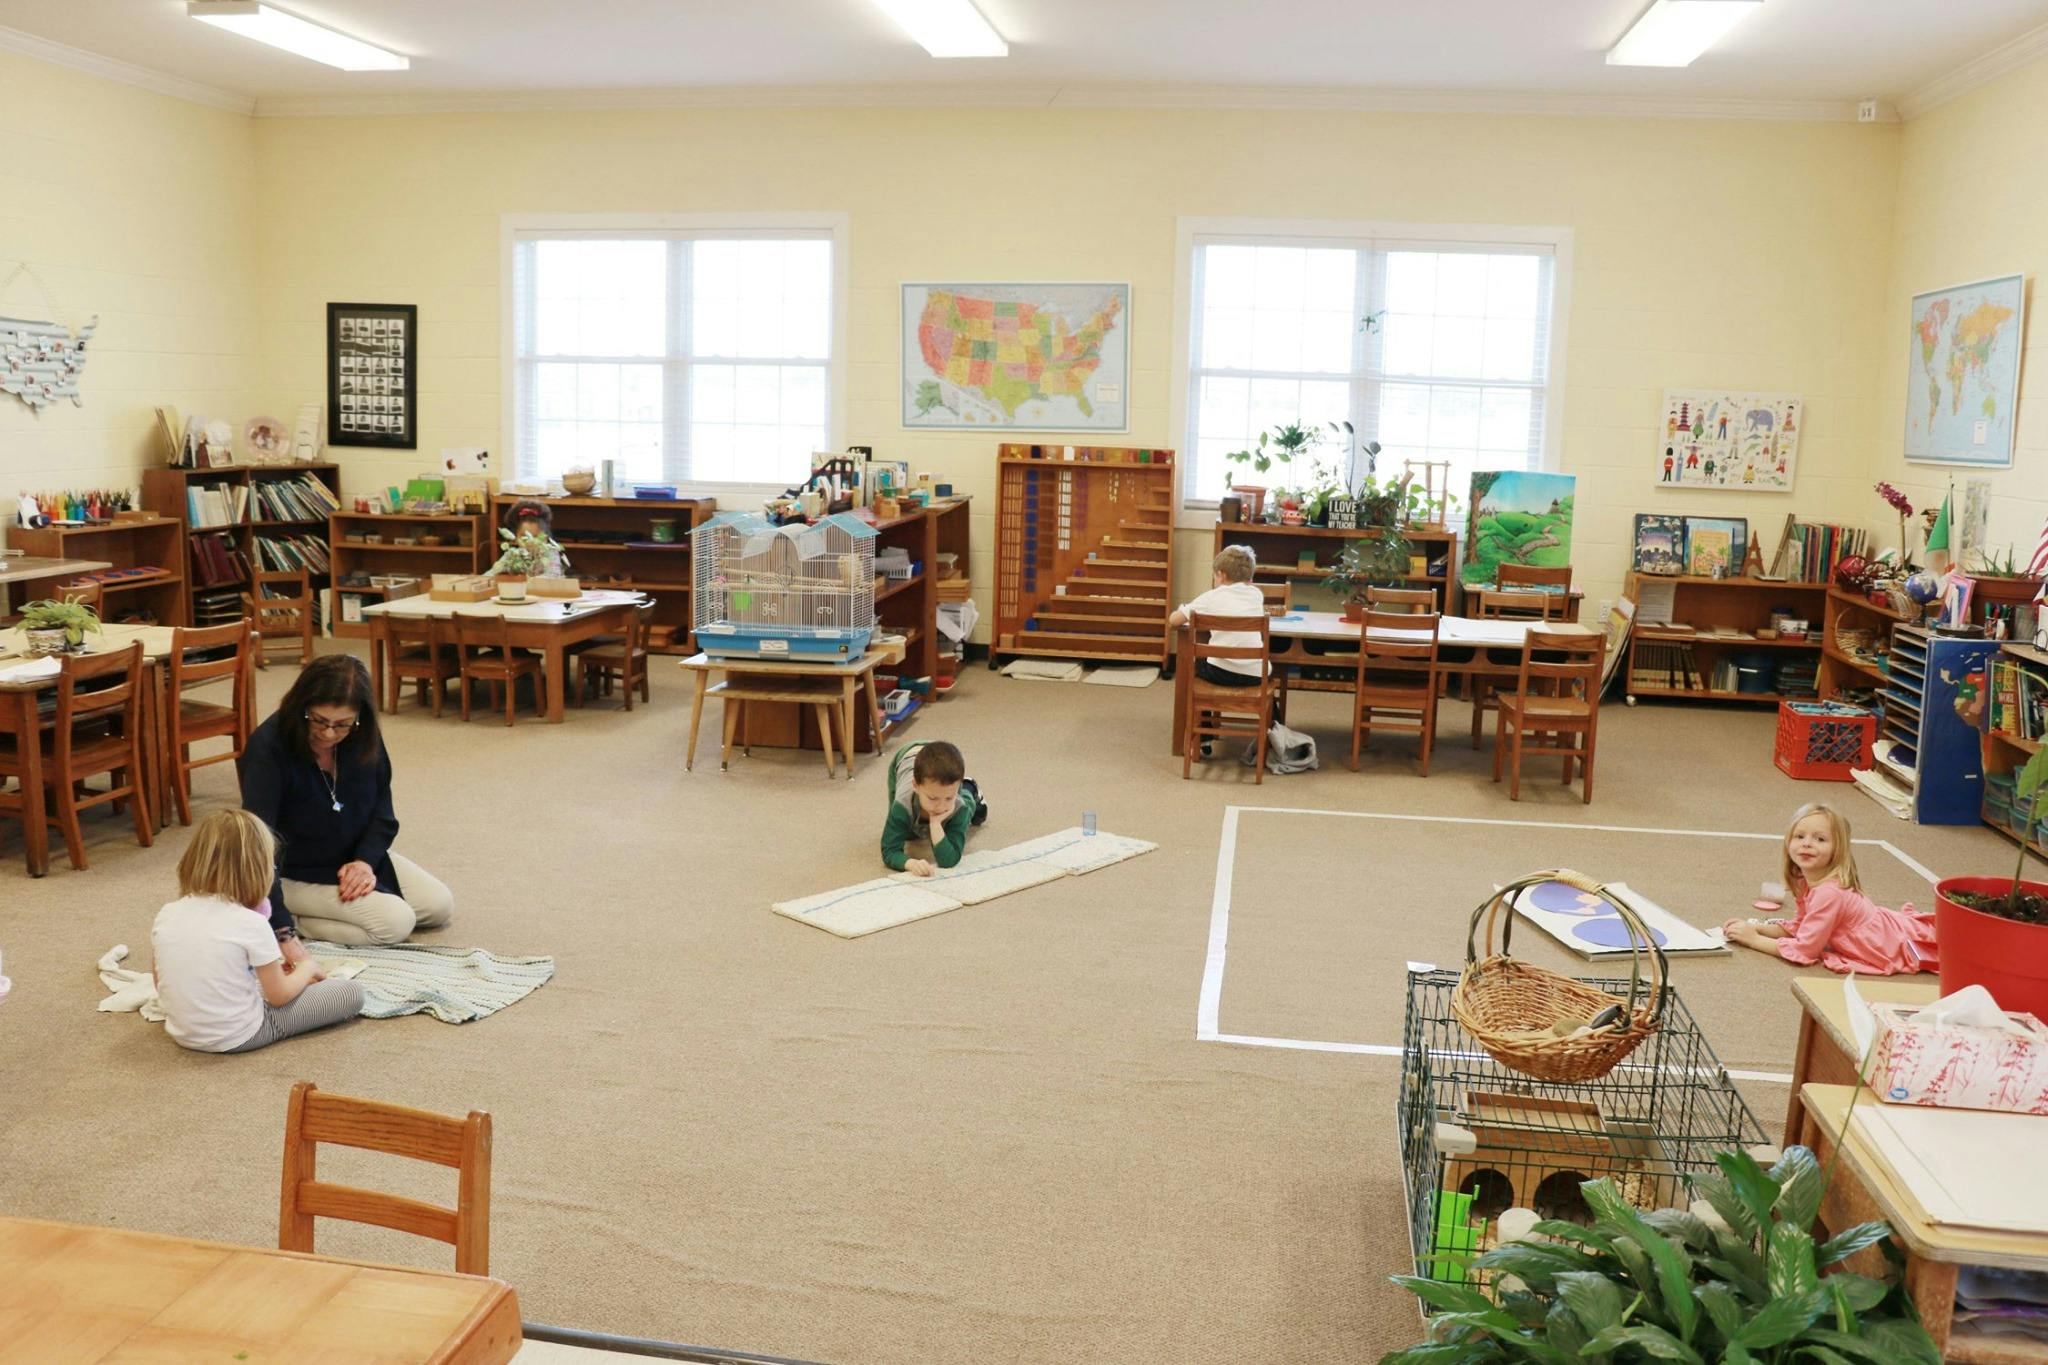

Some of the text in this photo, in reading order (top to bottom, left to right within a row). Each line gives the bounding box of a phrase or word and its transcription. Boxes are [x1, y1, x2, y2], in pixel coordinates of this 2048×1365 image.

[1334, 500, 1357, 513] LOVE
[1329, 512, 1340, 520] THAT
[1328, 520, 1356, 529] MY TEACHER
